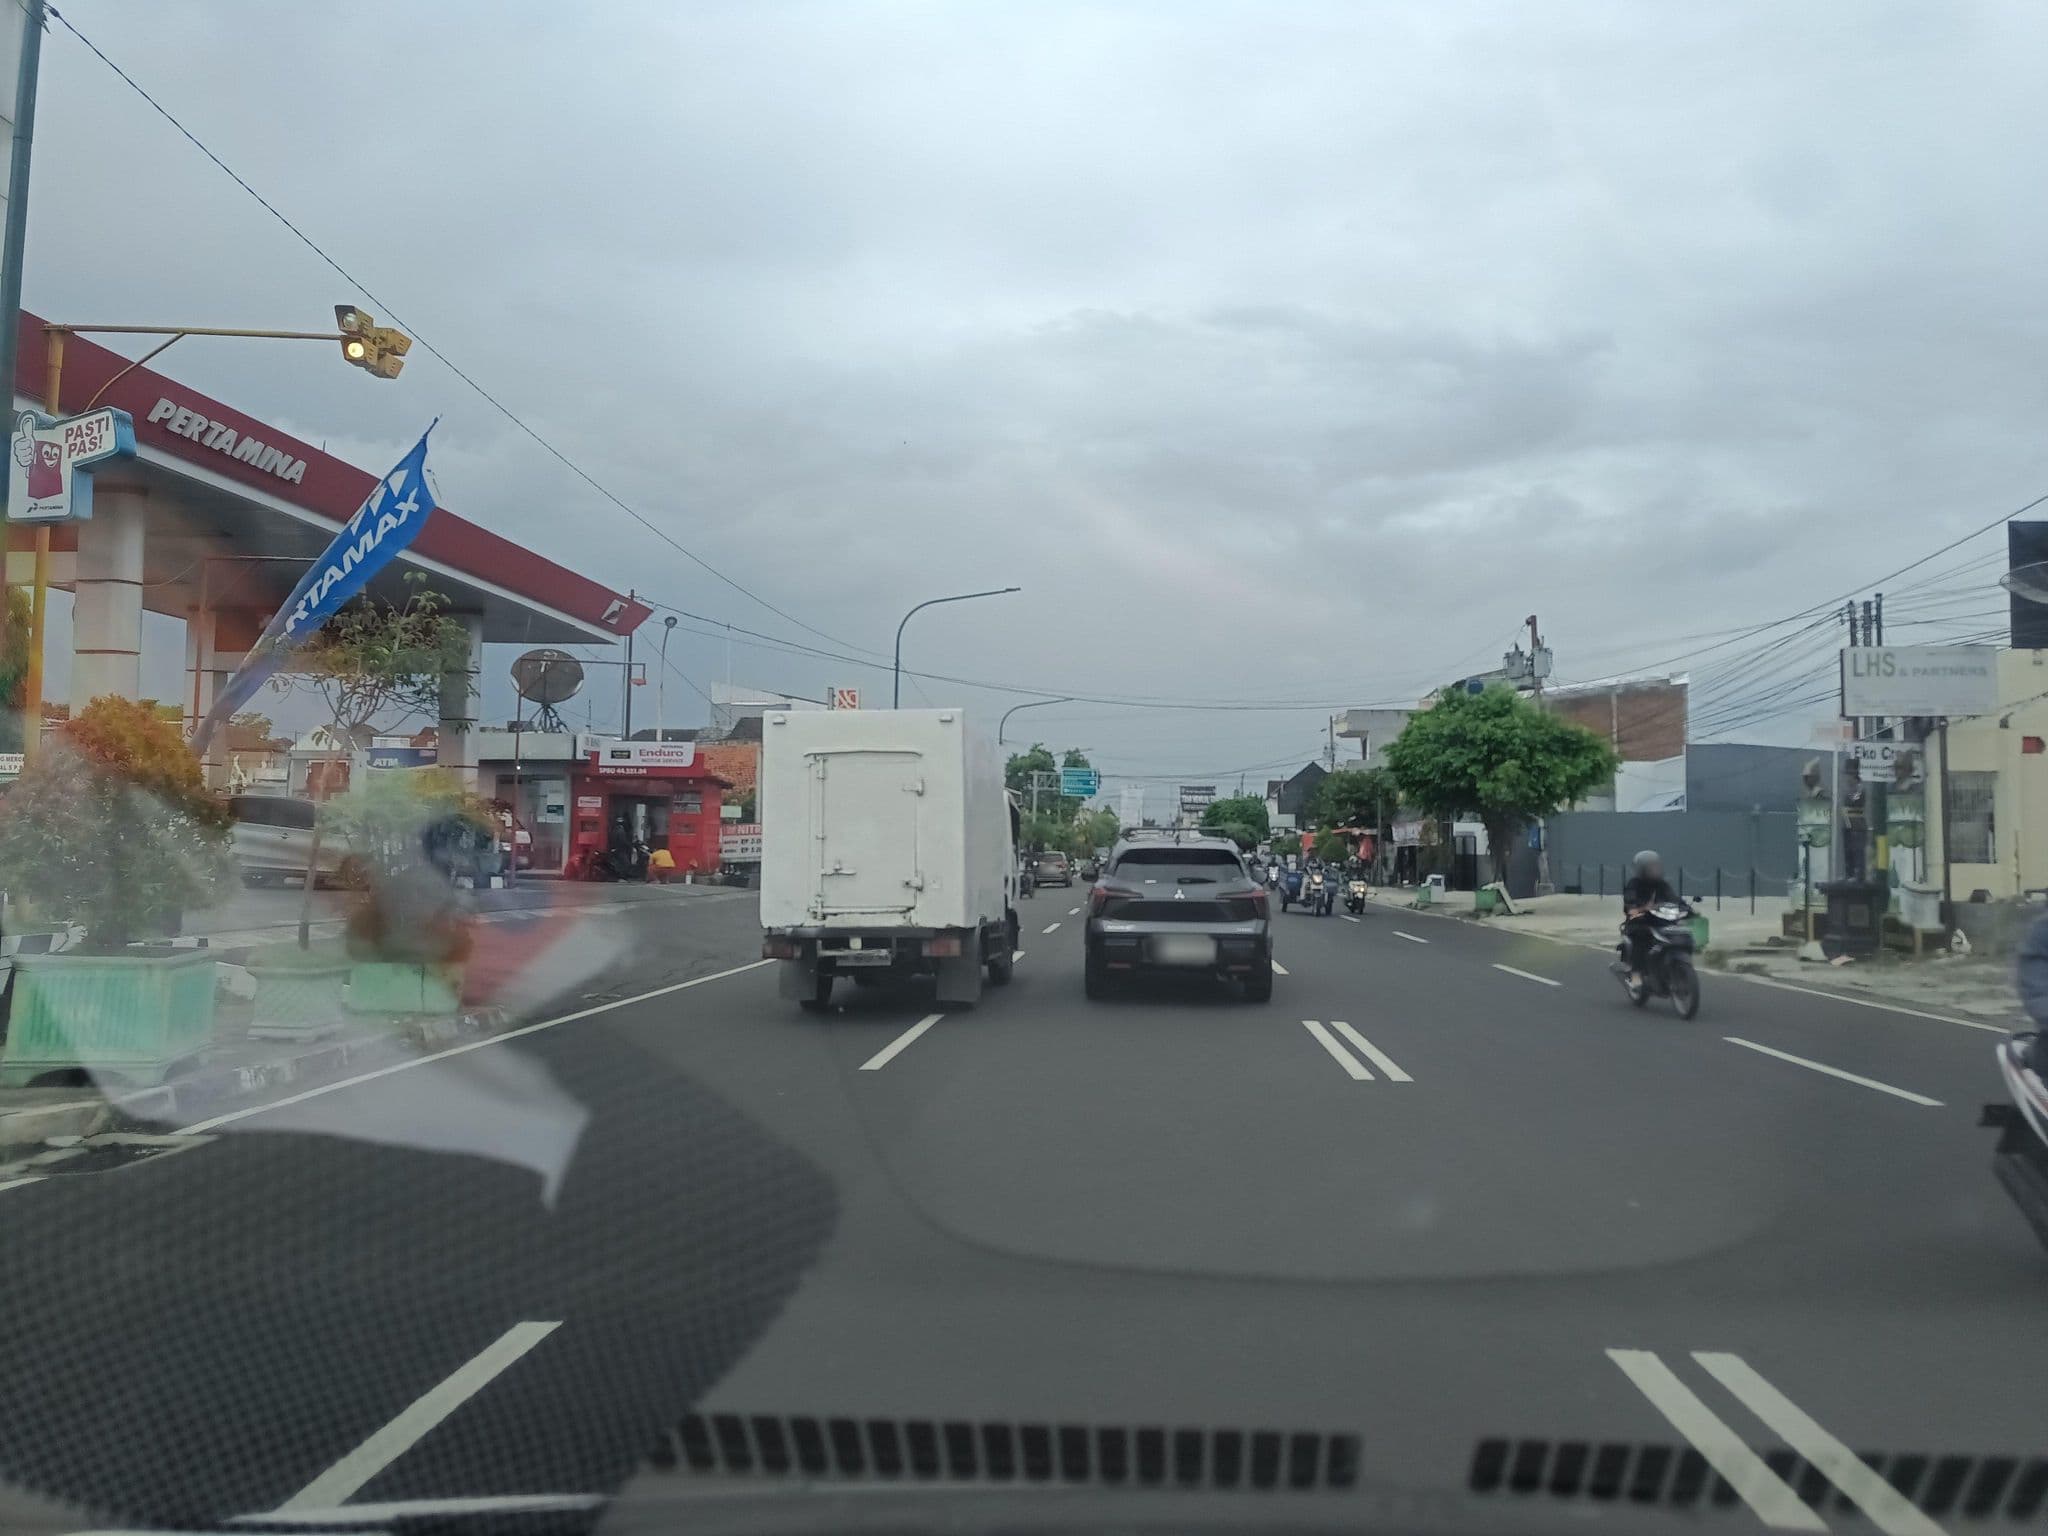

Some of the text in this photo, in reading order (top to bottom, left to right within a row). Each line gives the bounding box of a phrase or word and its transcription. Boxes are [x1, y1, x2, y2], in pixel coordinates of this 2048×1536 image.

[64, 415, 110, 443] PASTI
[147, 397, 307, 485] PERTAMINA
[67, 434, 103, 459] PAS!
[1852, 652, 1896, 678] LHS
[1912, 666, 1988, 678] PARTNERS
[638, 748, 684, 757] Enduro
